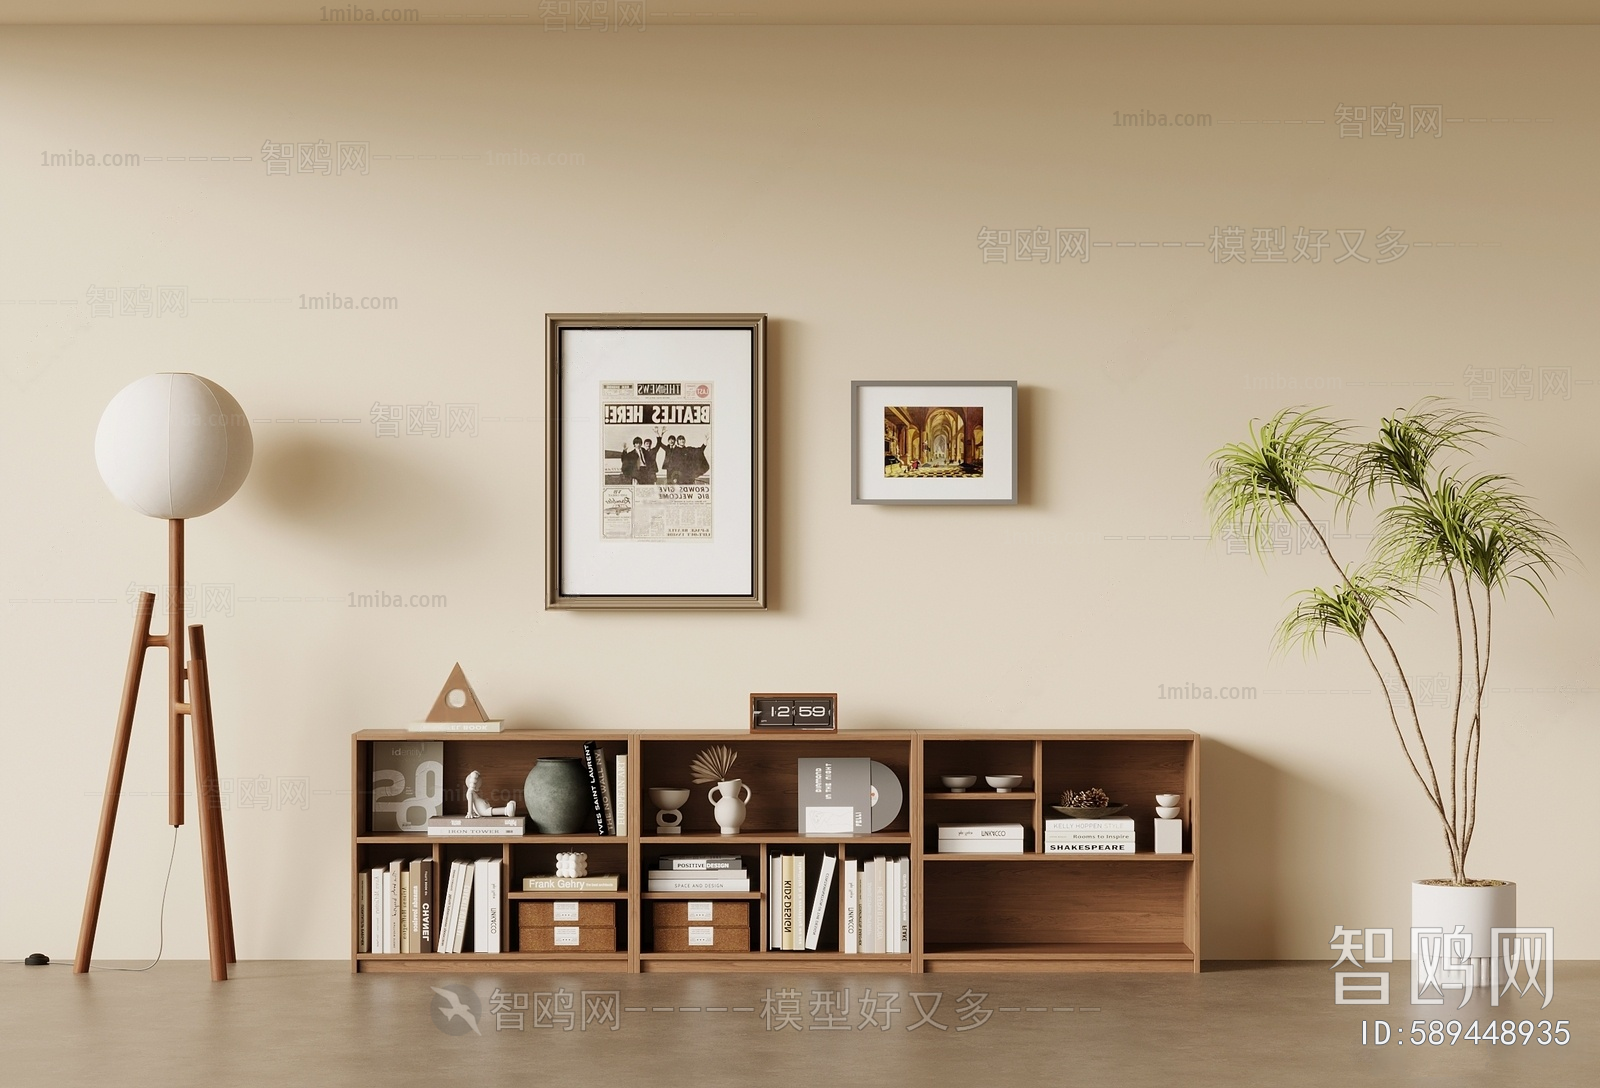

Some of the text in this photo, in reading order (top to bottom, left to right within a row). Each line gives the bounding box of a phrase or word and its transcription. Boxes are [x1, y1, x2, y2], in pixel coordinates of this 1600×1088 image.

[771, 706, 826, 717] 12 59
[598, 768, 607, 793] WALL
[584, 745, 604, 835] YVES SAINT LAURENT
[603, 797, 610, 810] NO
[529, 880, 554, 888] Frank
[557, 880, 585, 890] Gehry
